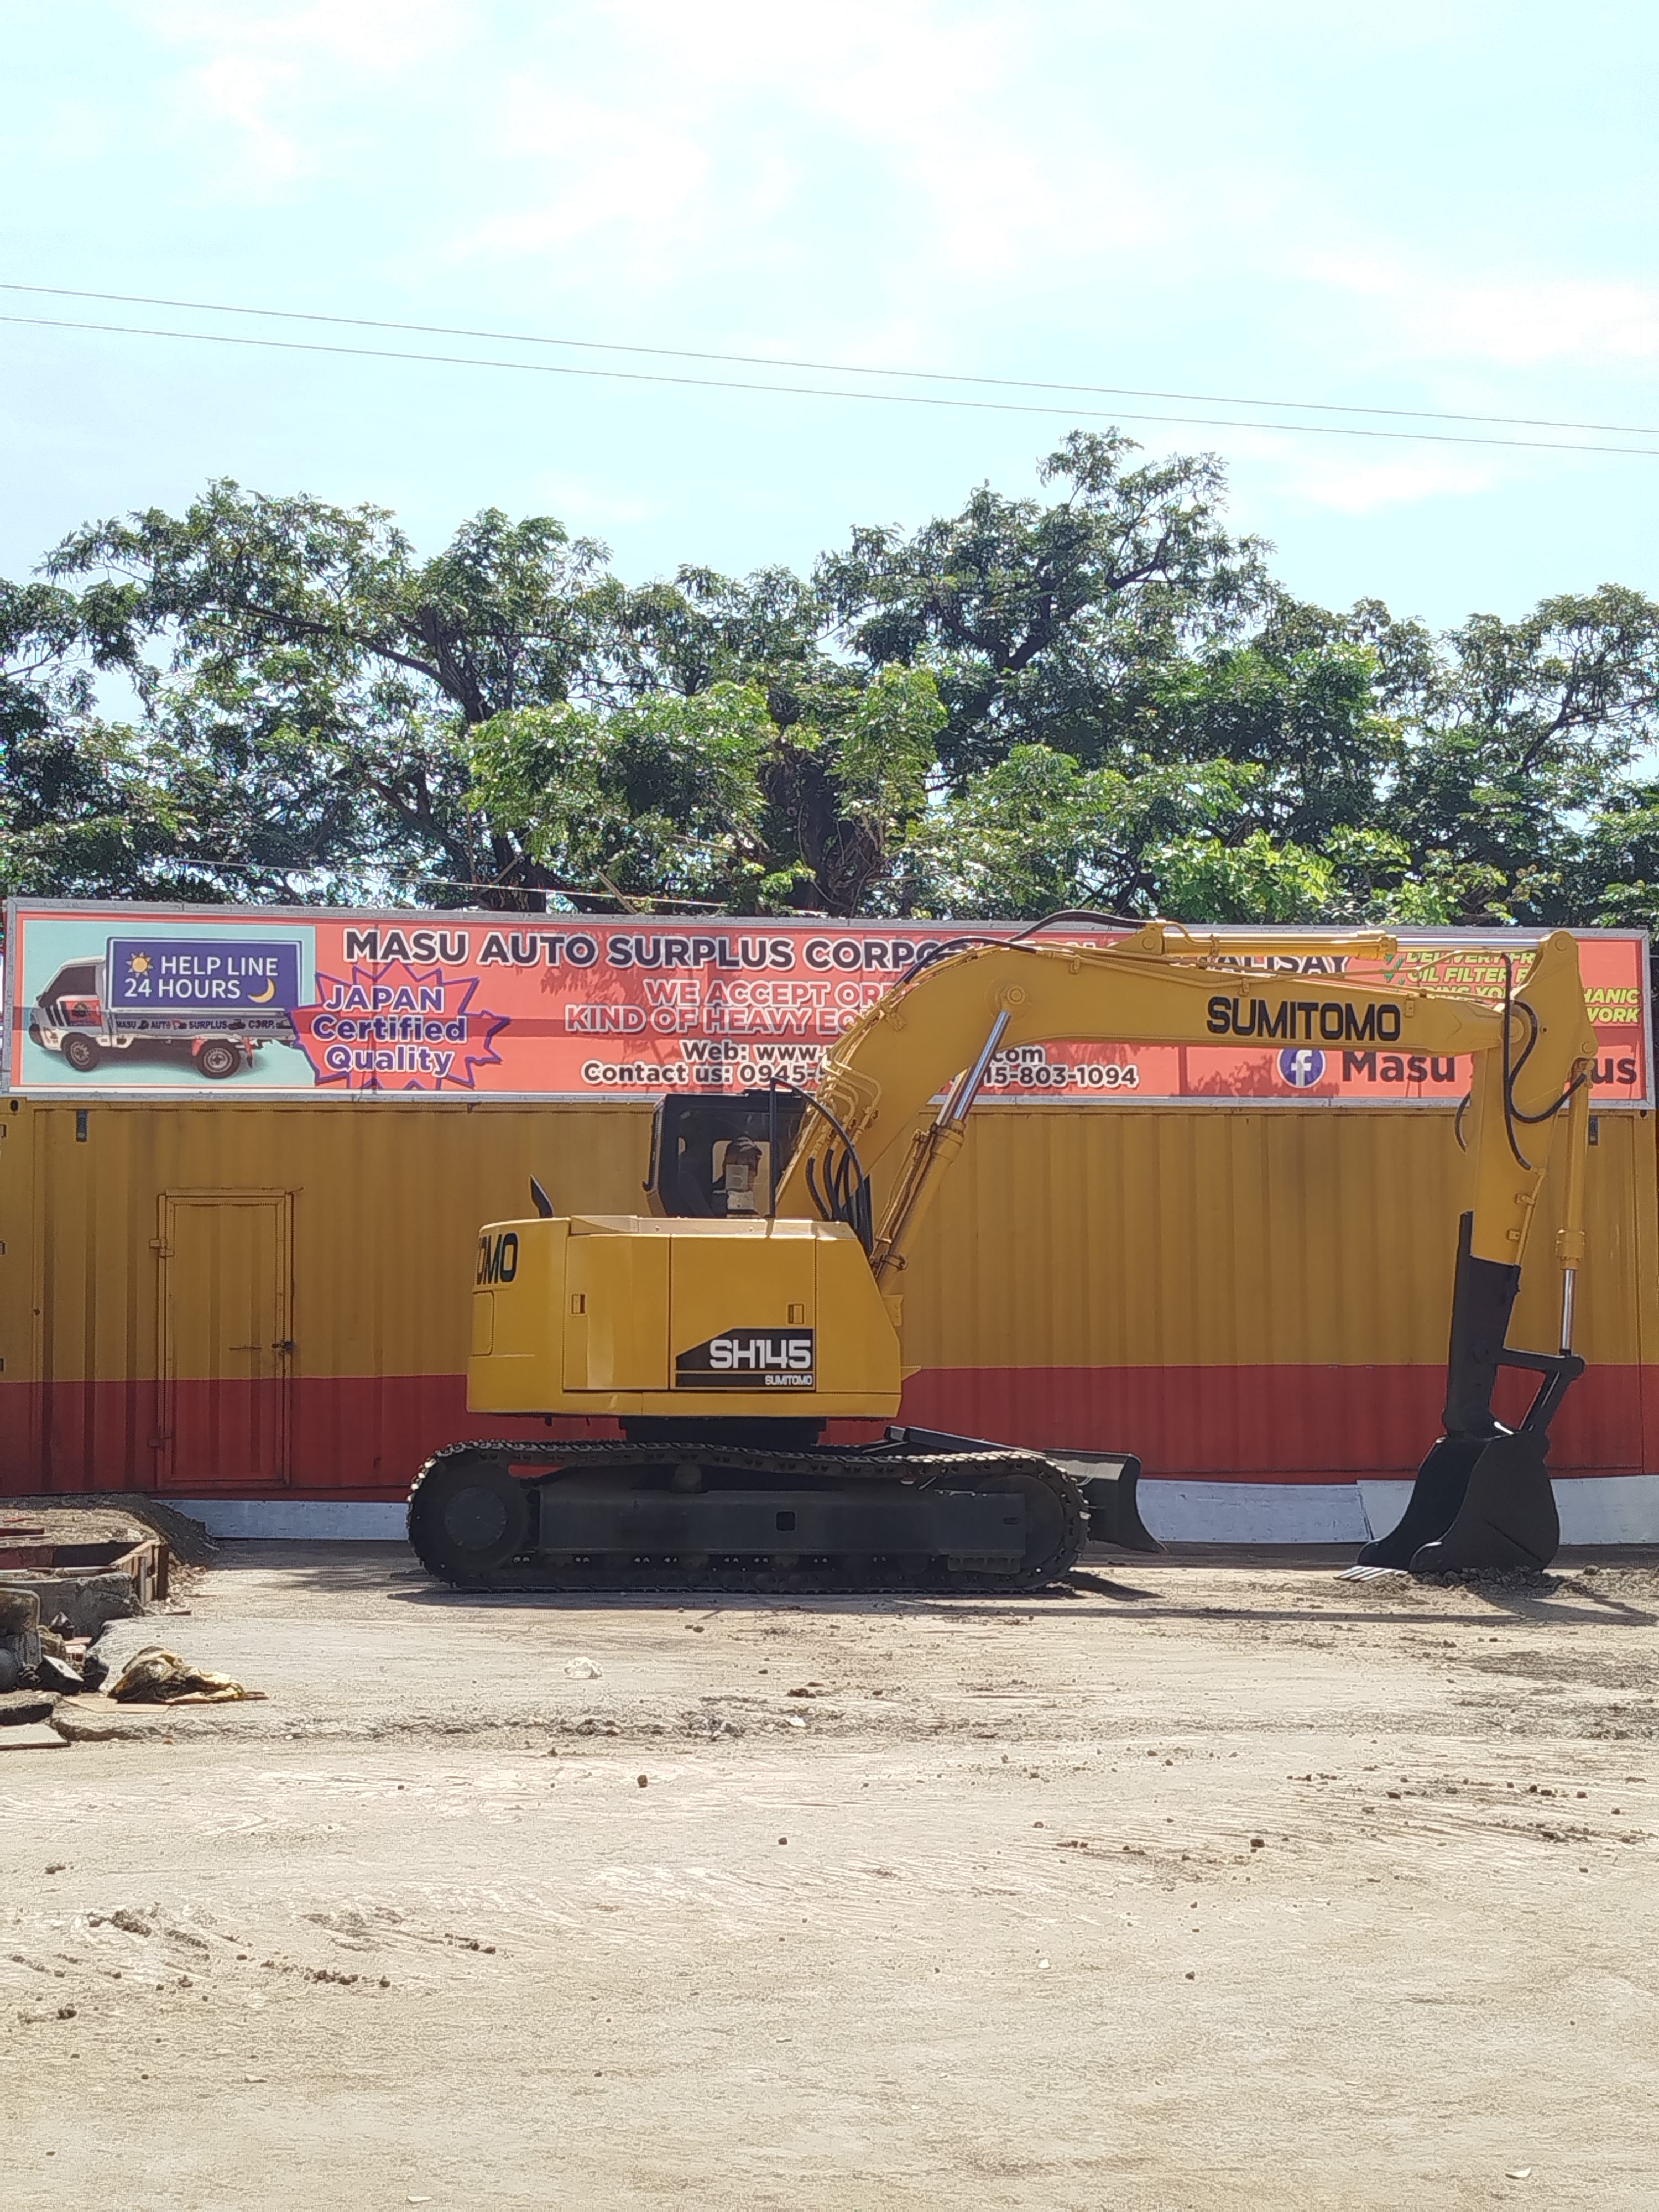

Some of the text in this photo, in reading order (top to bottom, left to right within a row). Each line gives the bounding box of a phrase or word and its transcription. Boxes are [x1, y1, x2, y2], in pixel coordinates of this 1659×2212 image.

[343, 928, 972, 972] MASU AUTO SURPLUS CORPO
[161, 956, 278, 977] HELP LINE
[1407, 967, 1440, 982] OIL
[124, 978, 241, 999] 24 HOURS
[325, 985, 445, 1012] JAPAN
[644, 979, 700, 1006] WE
[704, 980, 832, 1008] ACCEPT
[1583, 988, 1640, 1004] HANIC
[189, 1020, 228, 1030] SURPLUS
[312, 1015, 468, 1043] Certified
[565, 1004, 646, 1032] KIND
[650, 1005, 698, 1033] OF
[703, 1007, 813, 1035] HEAVY
[1207, 996, 1401, 1041] SUMITOMO
[325, 1045, 456, 1077] Quality
[681, 1040, 748, 1063] Web:
[581, 1060, 689, 1084] Contact
[693, 1064, 733, 1085] us:
[983, 1063, 1140, 1088] 15-803-1094
[1342, 1051, 1455, 1082] Masu
[1590, 1057, 1637, 1084] us
[477, 1232, 519, 1286] OMO
[709, 1339, 811, 1369] SH145
[765, 1375, 812, 1385] SUMITOMO
